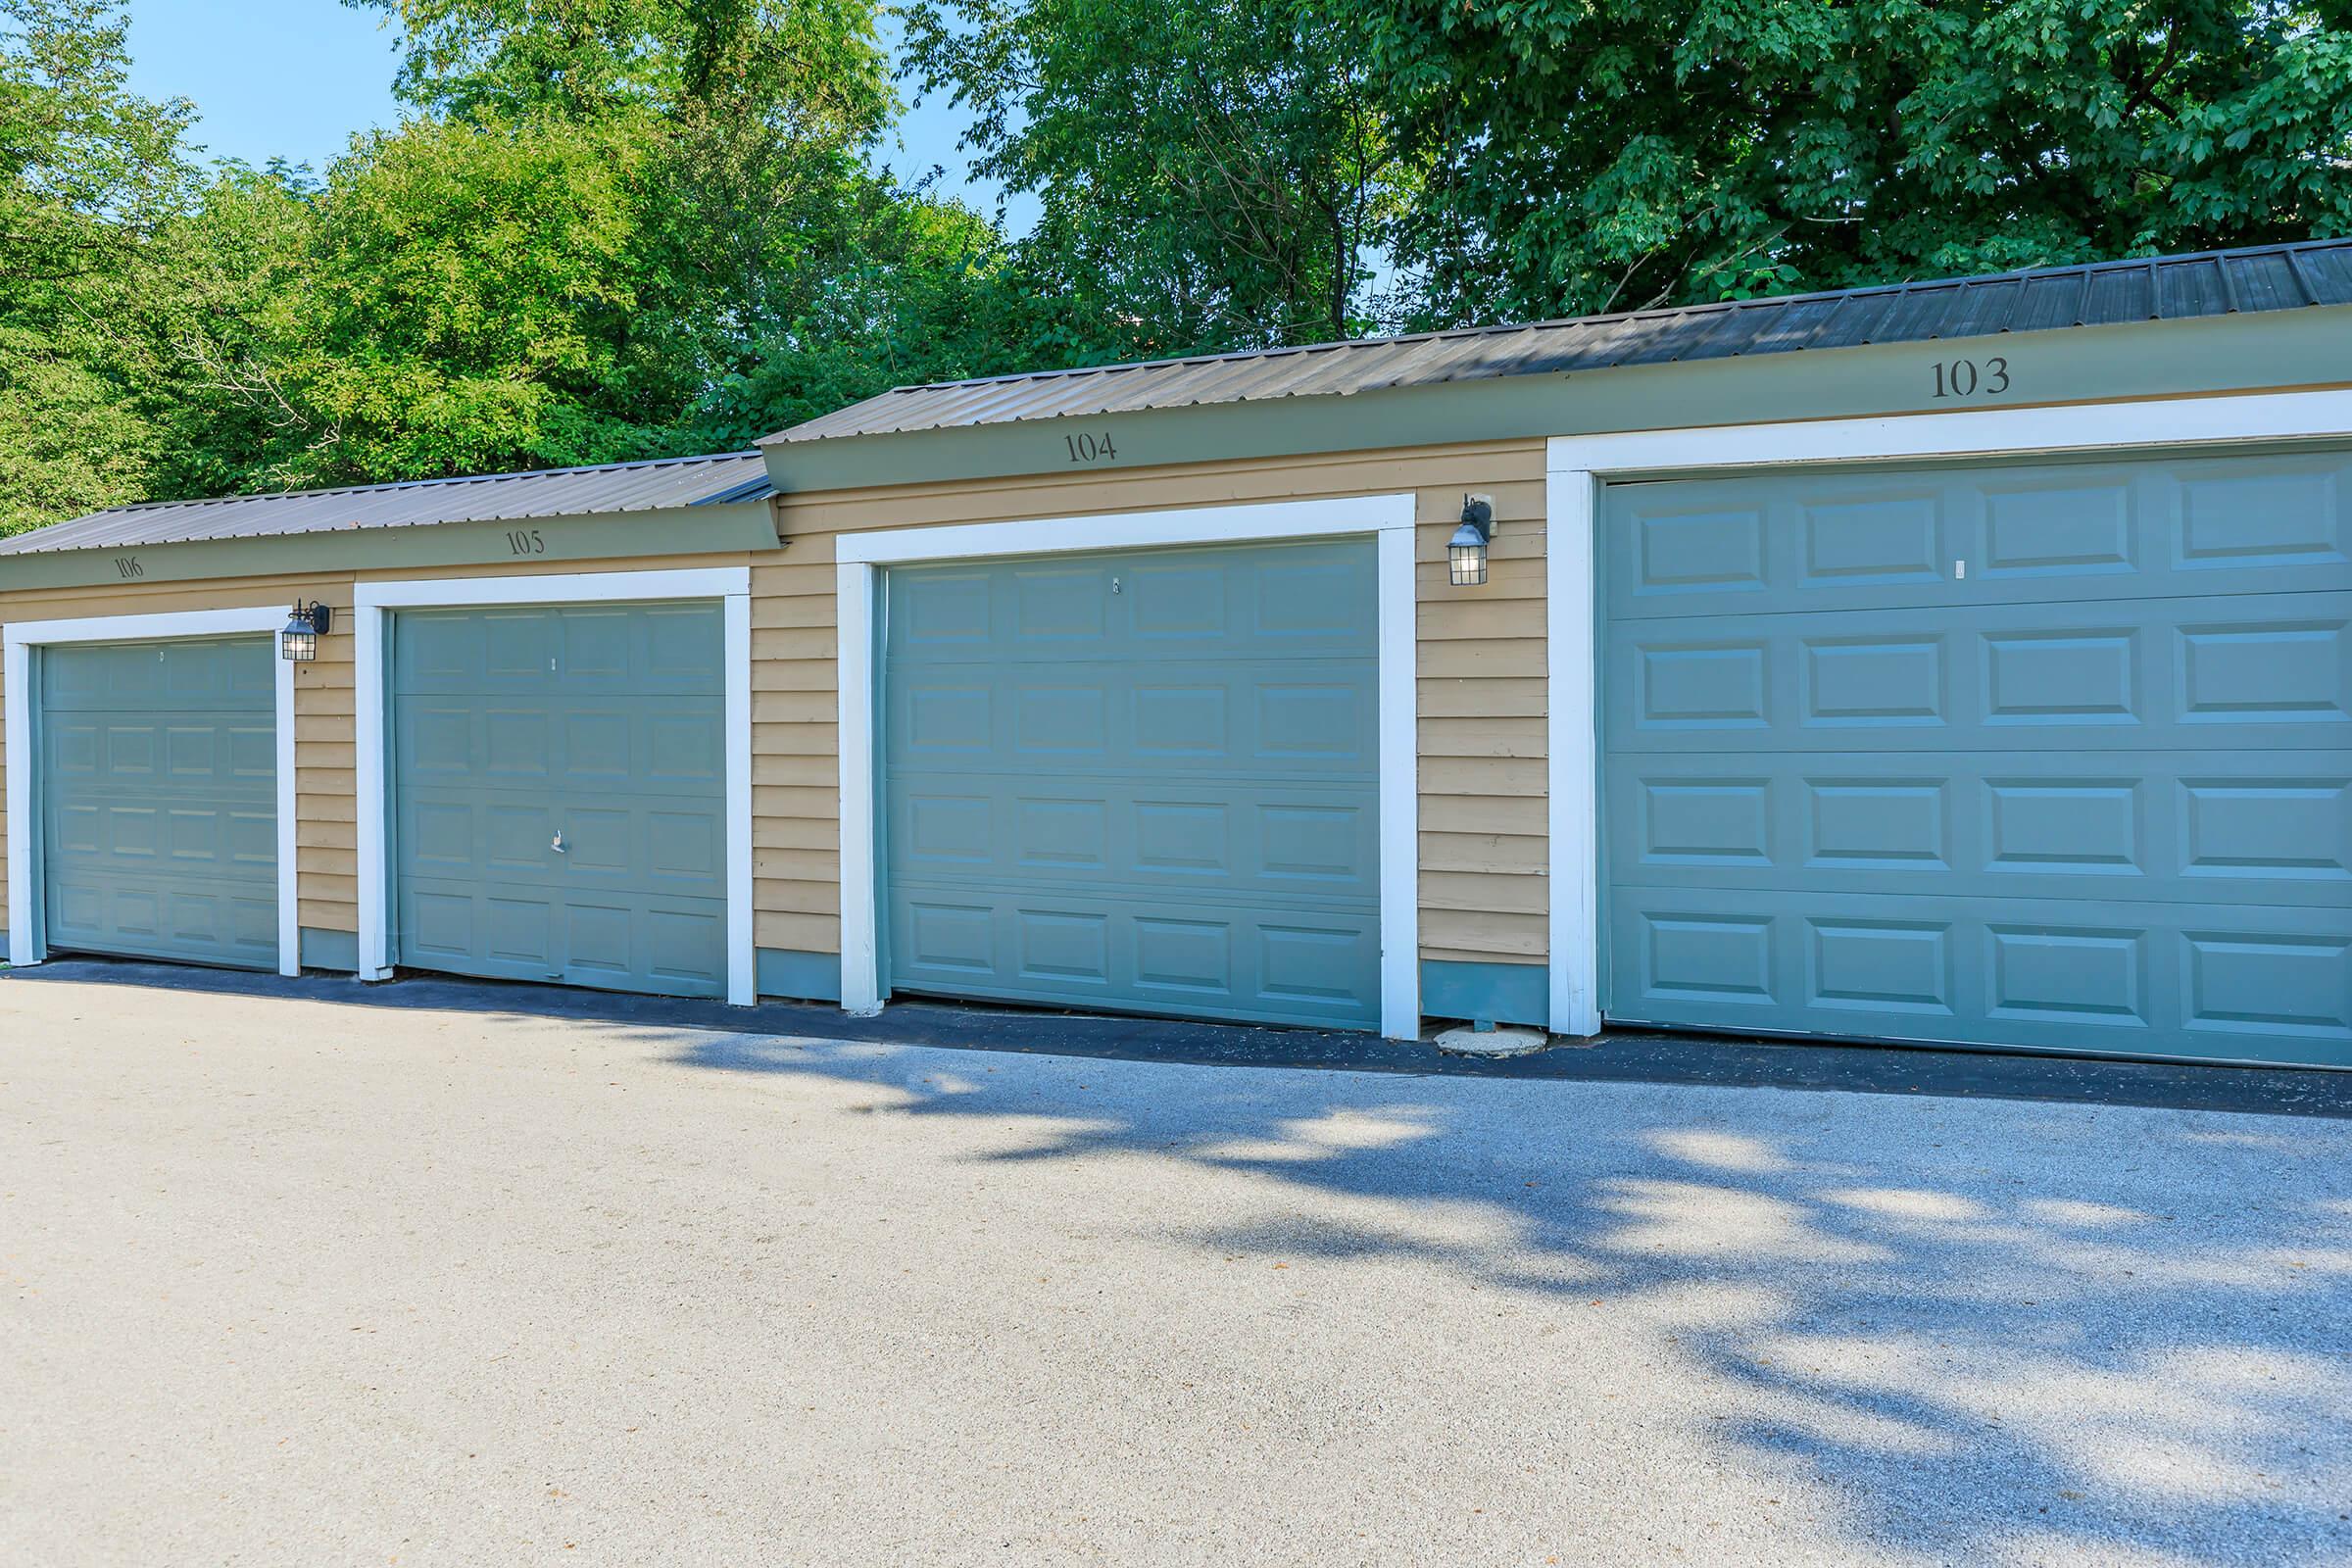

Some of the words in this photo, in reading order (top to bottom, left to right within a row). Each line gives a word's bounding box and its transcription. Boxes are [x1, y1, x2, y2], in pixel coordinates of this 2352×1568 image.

[1930, 357, 2010, 398] 103
[1063, 431, 1117, 463] 104
[506, 529, 545, 555] 105
[114, 556, 144, 578] 106
